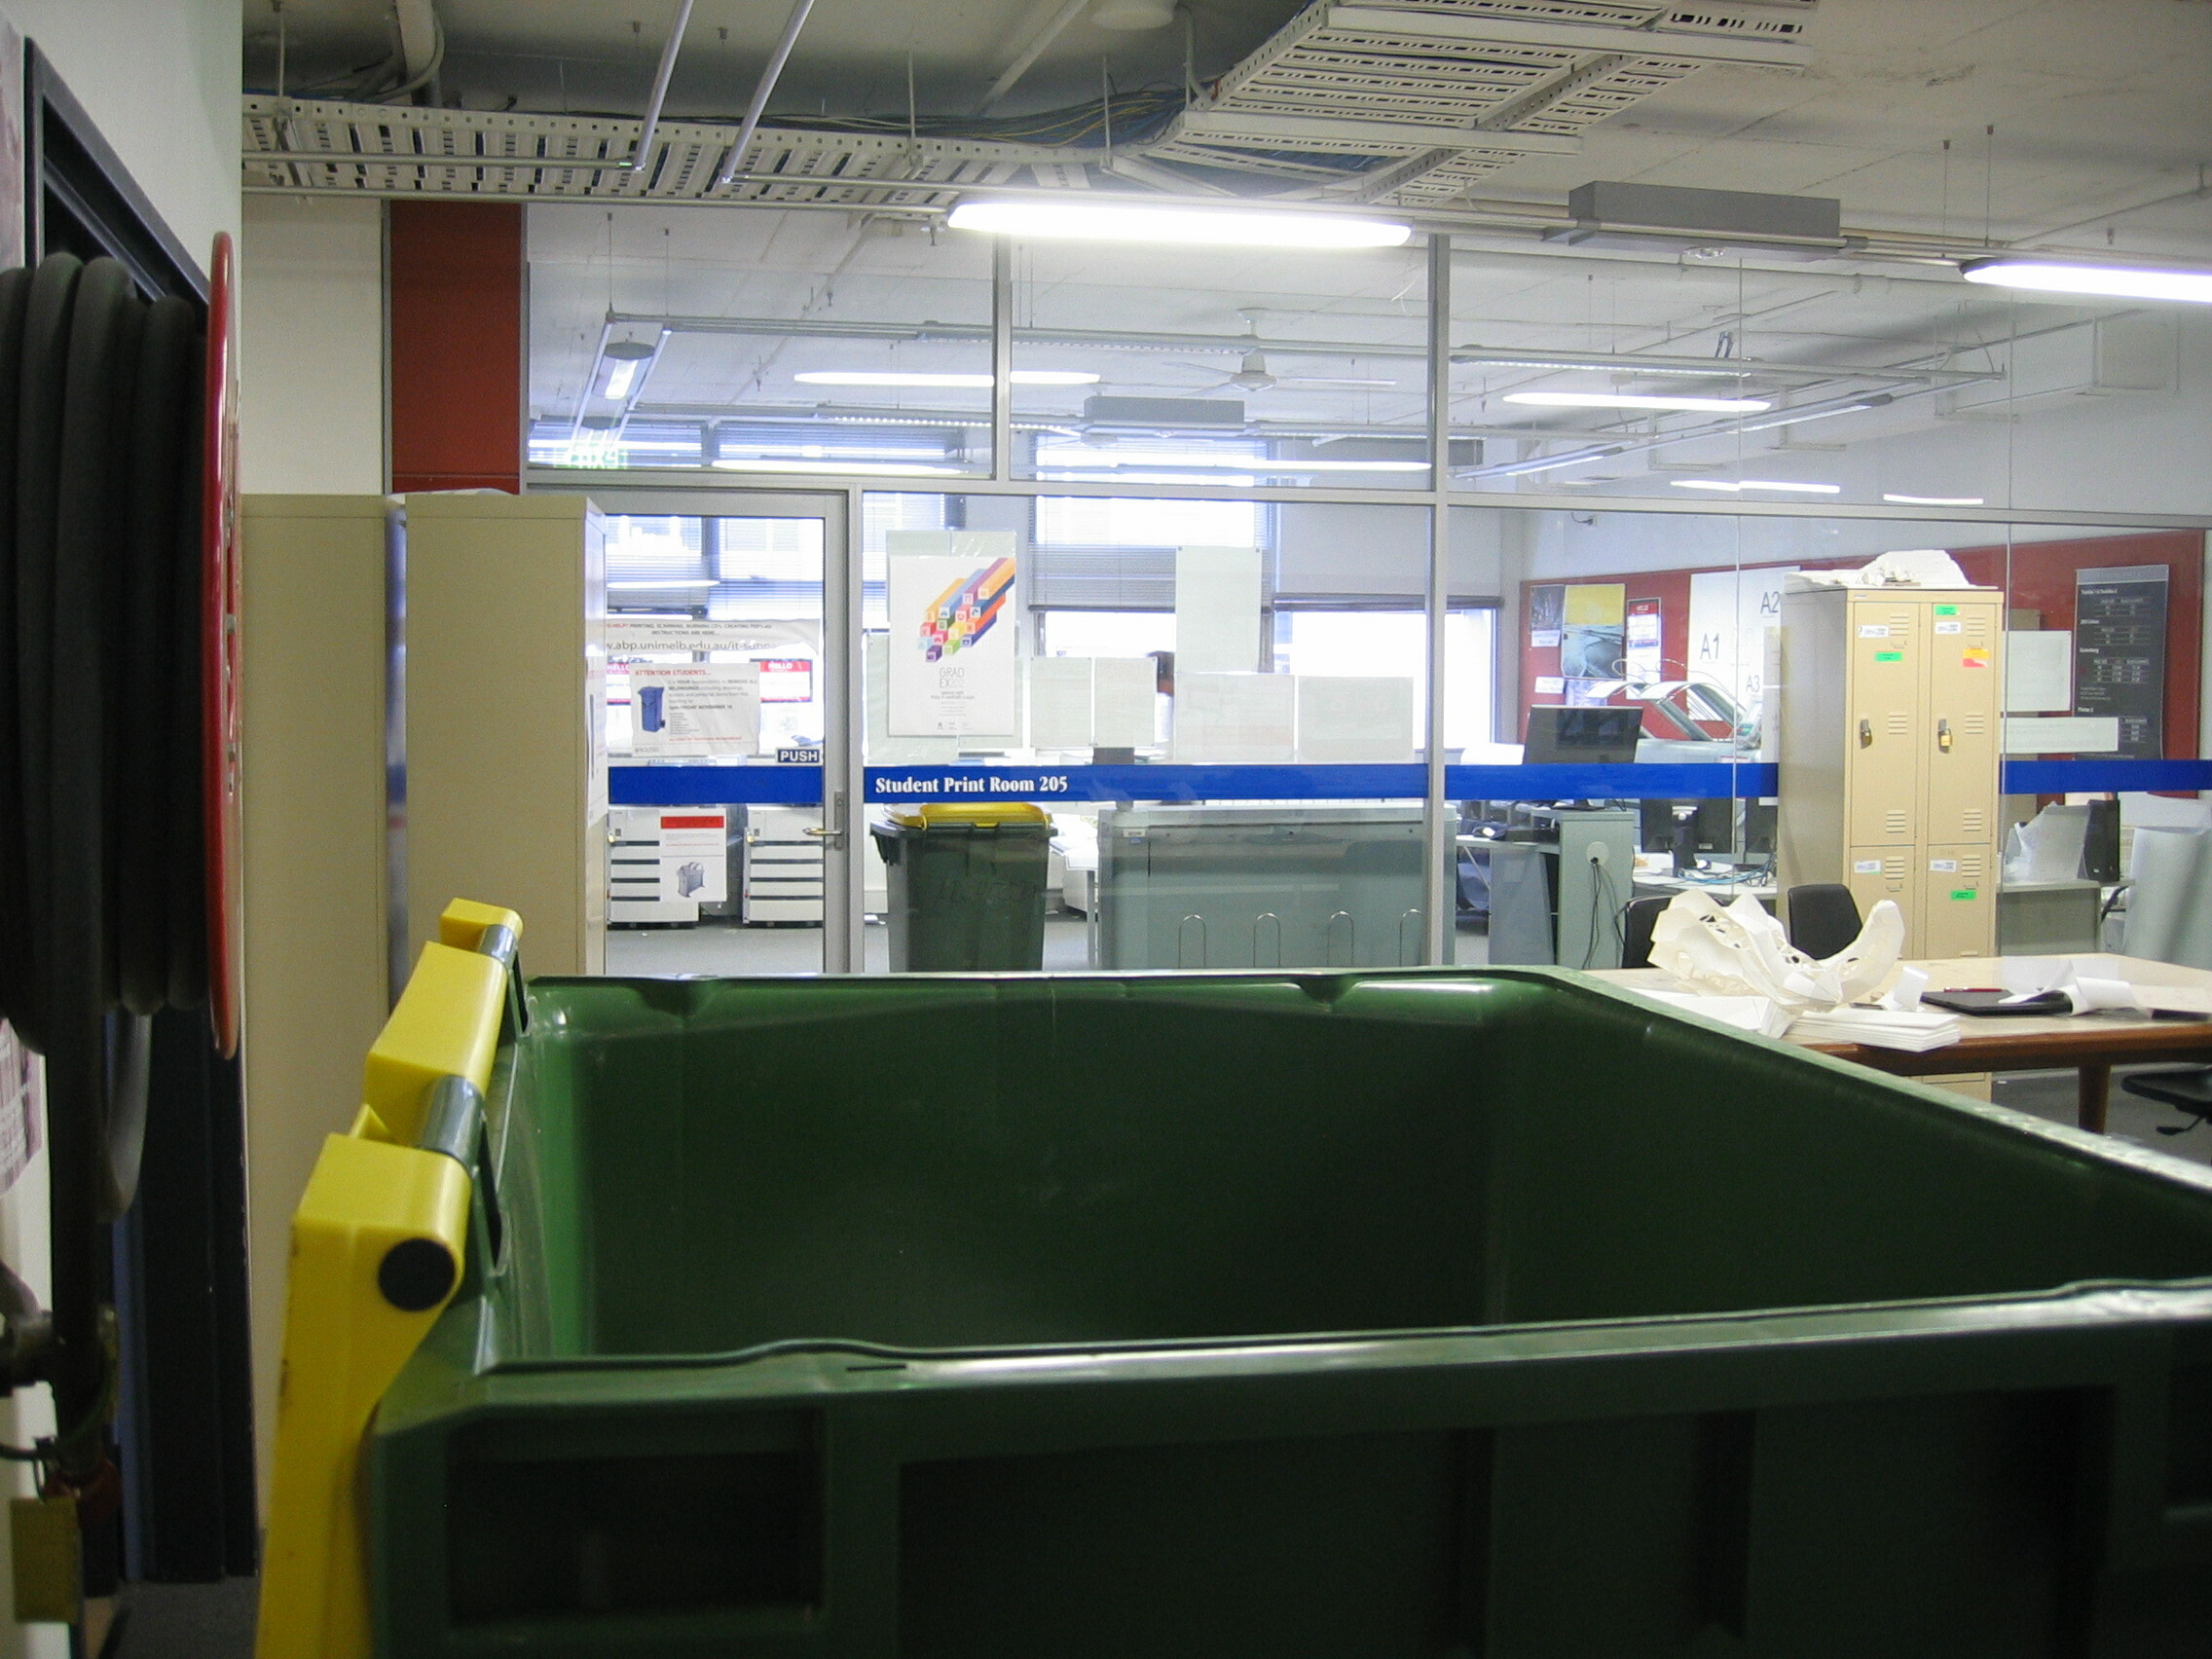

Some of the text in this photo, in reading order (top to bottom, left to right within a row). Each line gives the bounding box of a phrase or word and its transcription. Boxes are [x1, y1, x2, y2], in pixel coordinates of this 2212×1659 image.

[1760, 591, 1780, 614] A2
[1700, 633, 1719, 660] A1
[939, 667, 965, 678] GRAD
[1745, 675, 1760, 692] A3
[780, 750, 819, 762] PUSH
[875, 776, 1068, 793] Student Print Room 205
